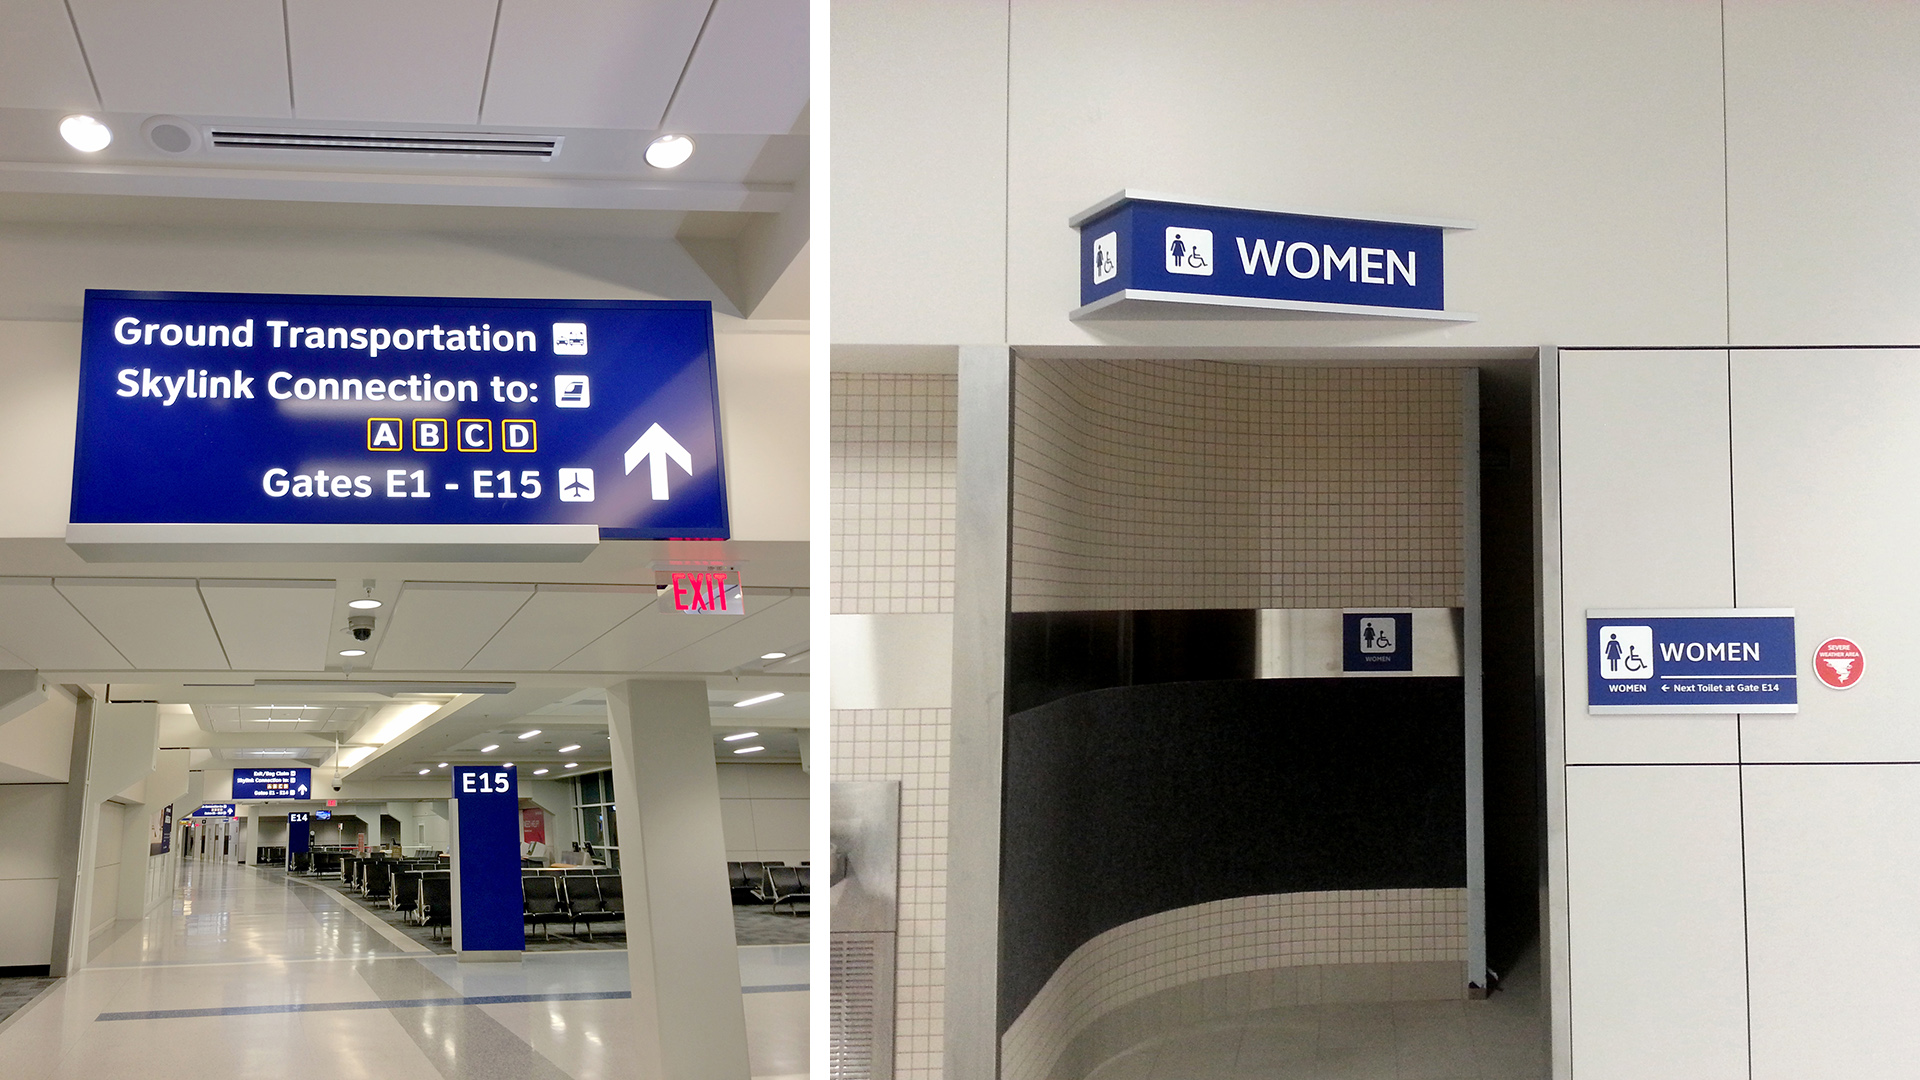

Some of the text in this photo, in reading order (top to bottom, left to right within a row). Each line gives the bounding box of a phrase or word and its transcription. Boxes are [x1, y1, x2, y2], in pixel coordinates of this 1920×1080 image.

[1235, 236, 1416, 287] WOMEN
[114, 316, 537, 358] Ground Transportation
[116, 367, 539, 407] Skylink Connection to:
[373, 422, 530, 448] A B C D
[262, 468, 372, 498] Gates
[386, 469, 431, 498] E1
[473, 470, 542, 499] E15
[672, 573, 727, 611] EXIT
[1659, 642, 1760, 662] WOMEN
[1608, 684, 1647, 693] WOMEN
[1673, 683, 1780, 692] Next Toilet at Gate E14
[462, 772, 510, 793] E15
[290, 813, 308, 822] E14
